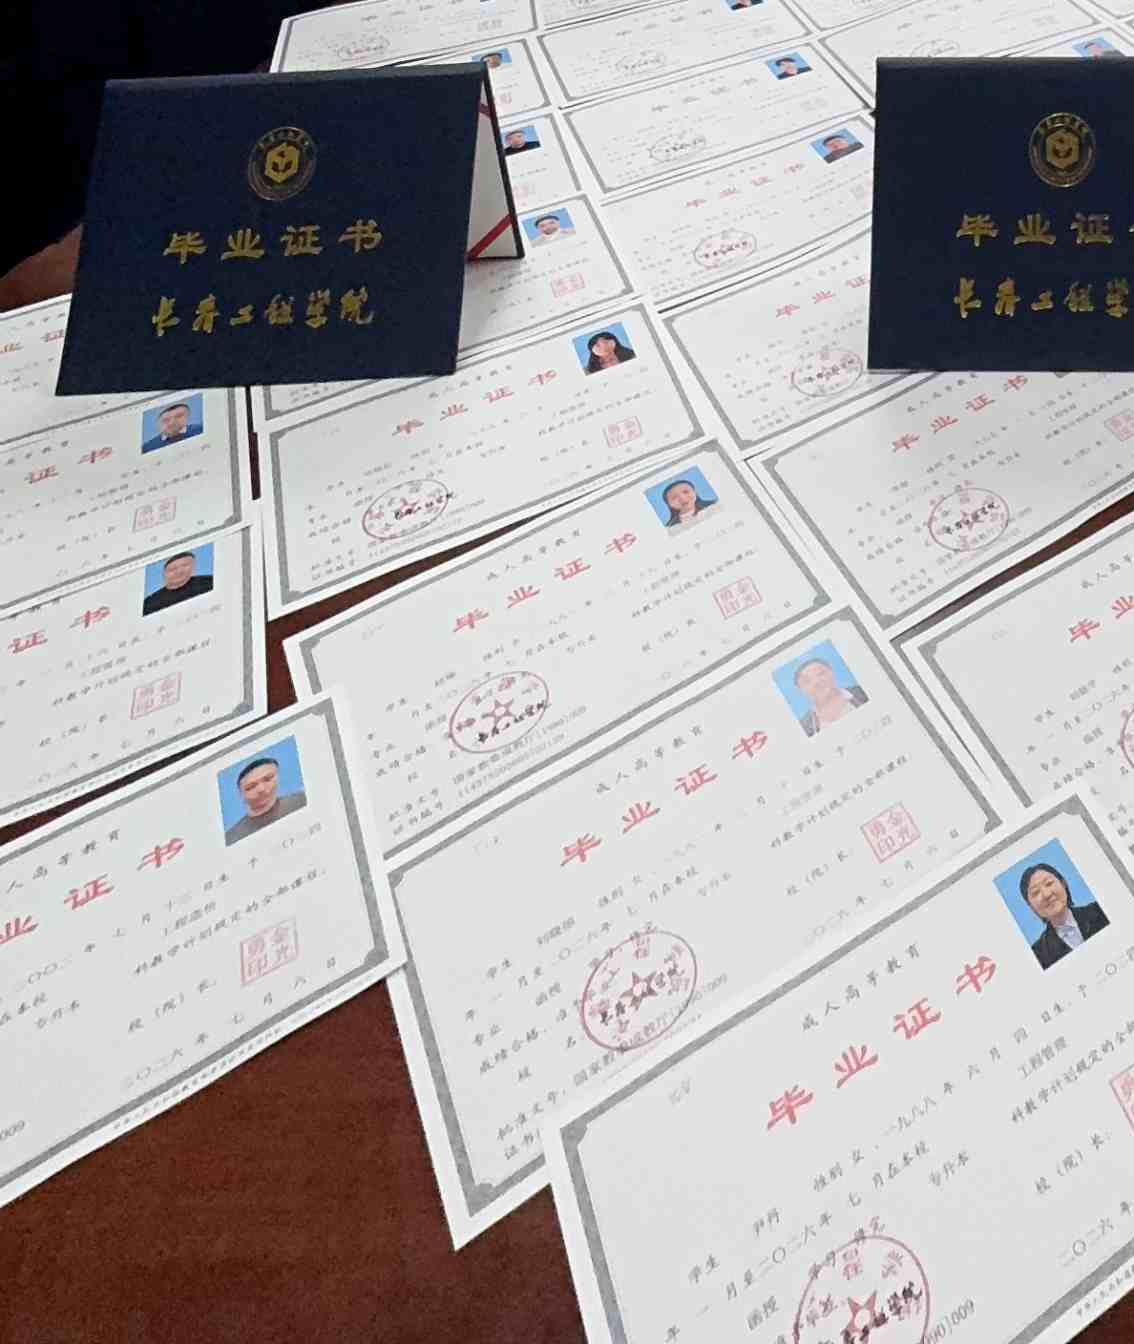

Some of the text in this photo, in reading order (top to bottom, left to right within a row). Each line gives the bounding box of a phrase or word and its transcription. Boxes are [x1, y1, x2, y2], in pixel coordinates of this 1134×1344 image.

[162, 217, 385, 264] 毕业证书
[151, 285, 375, 336] 长春工程学院
[892, 374, 1029, 453] 毕业证书
[453, 533, 637, 632] 毕业证书
[560, 731, 768, 867] 毕业证书
[802, 944, 920, 1032] 成人高等教育
[767, 956, 996, 1130] 毕业证书
